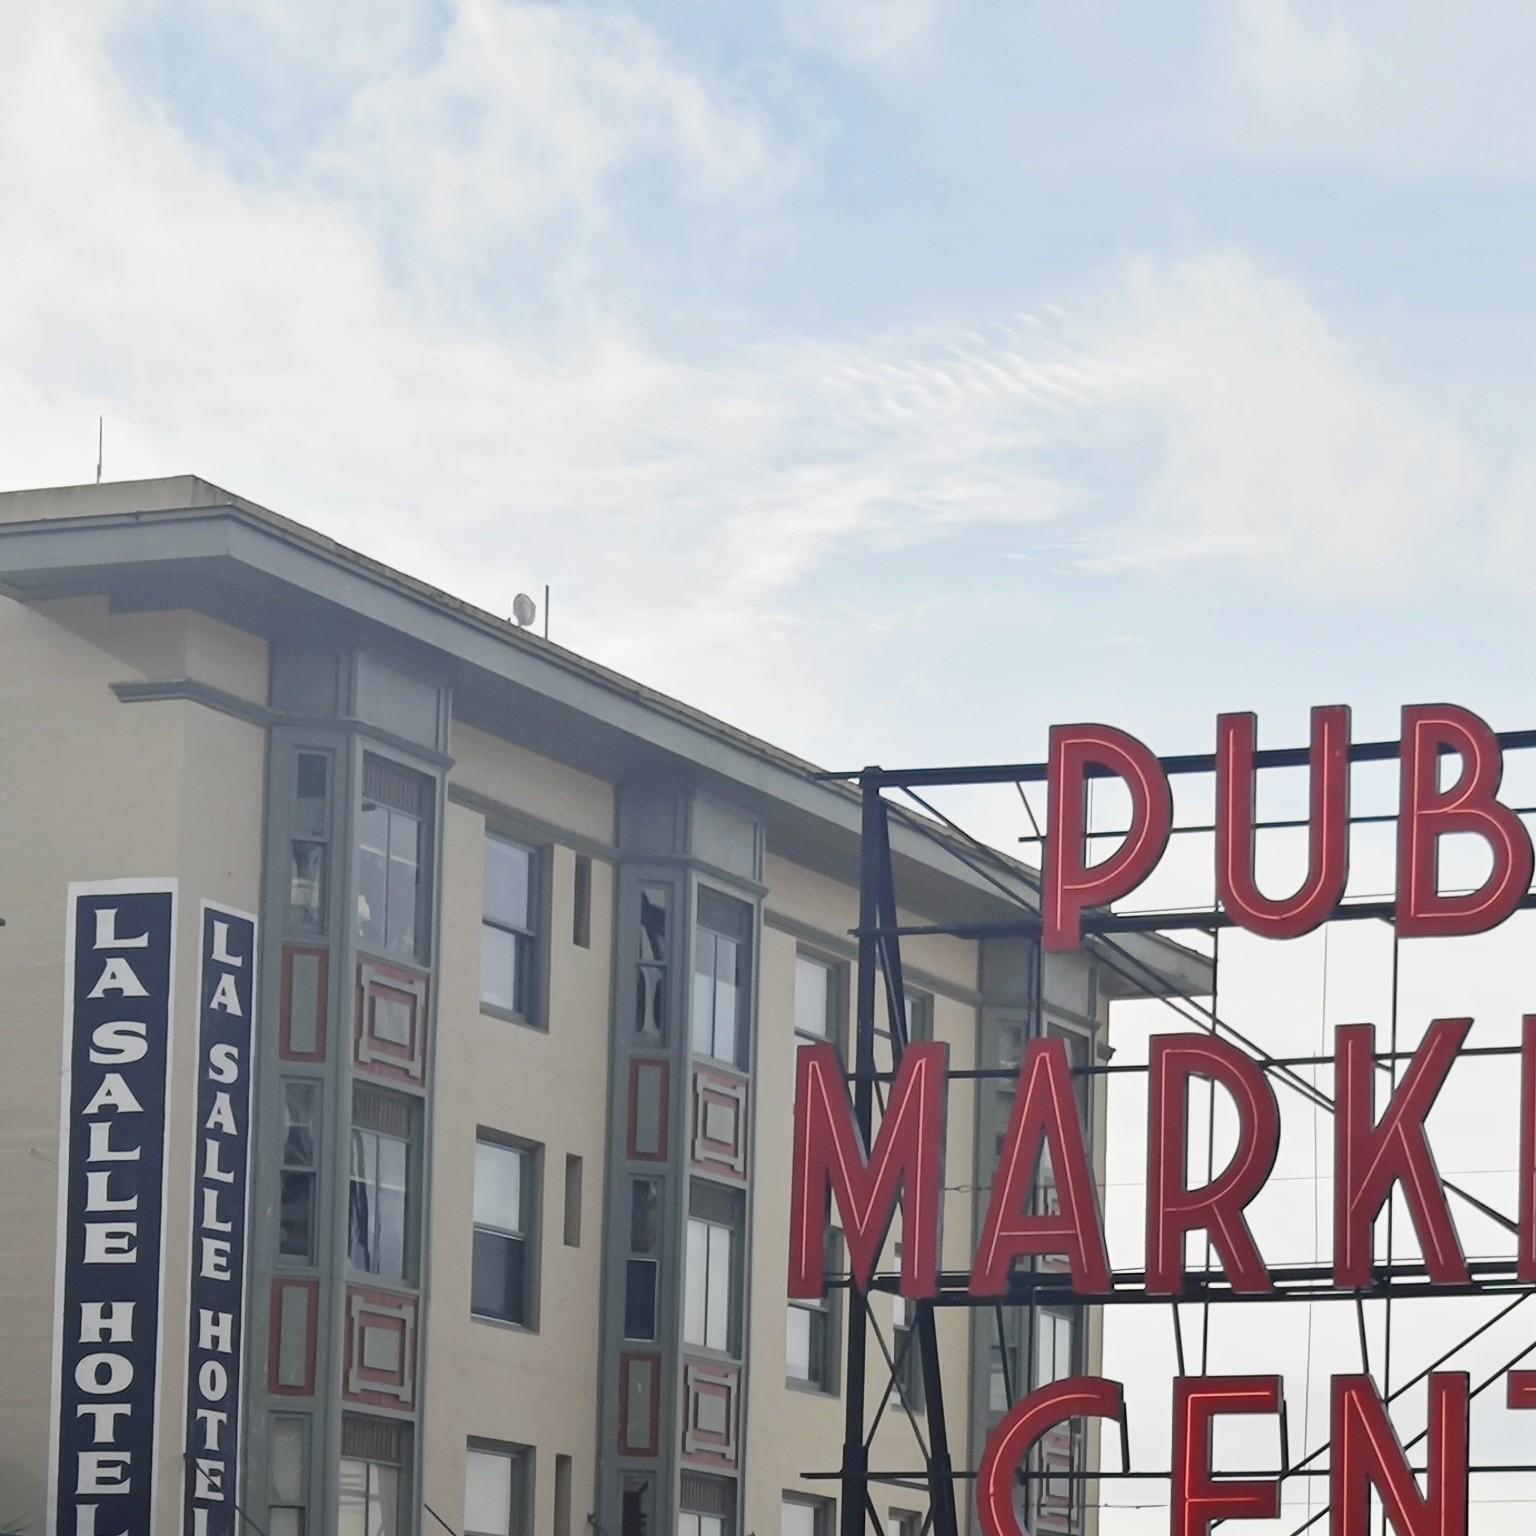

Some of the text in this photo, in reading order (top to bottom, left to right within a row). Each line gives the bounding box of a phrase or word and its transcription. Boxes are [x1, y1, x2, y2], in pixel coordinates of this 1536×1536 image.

[87, 908, 149, 997] LA
[209, 921, 242, 1017] LA
[82, 1021, 148, 1264] SALLE
[200, 1044, 239, 1281] SALLE
